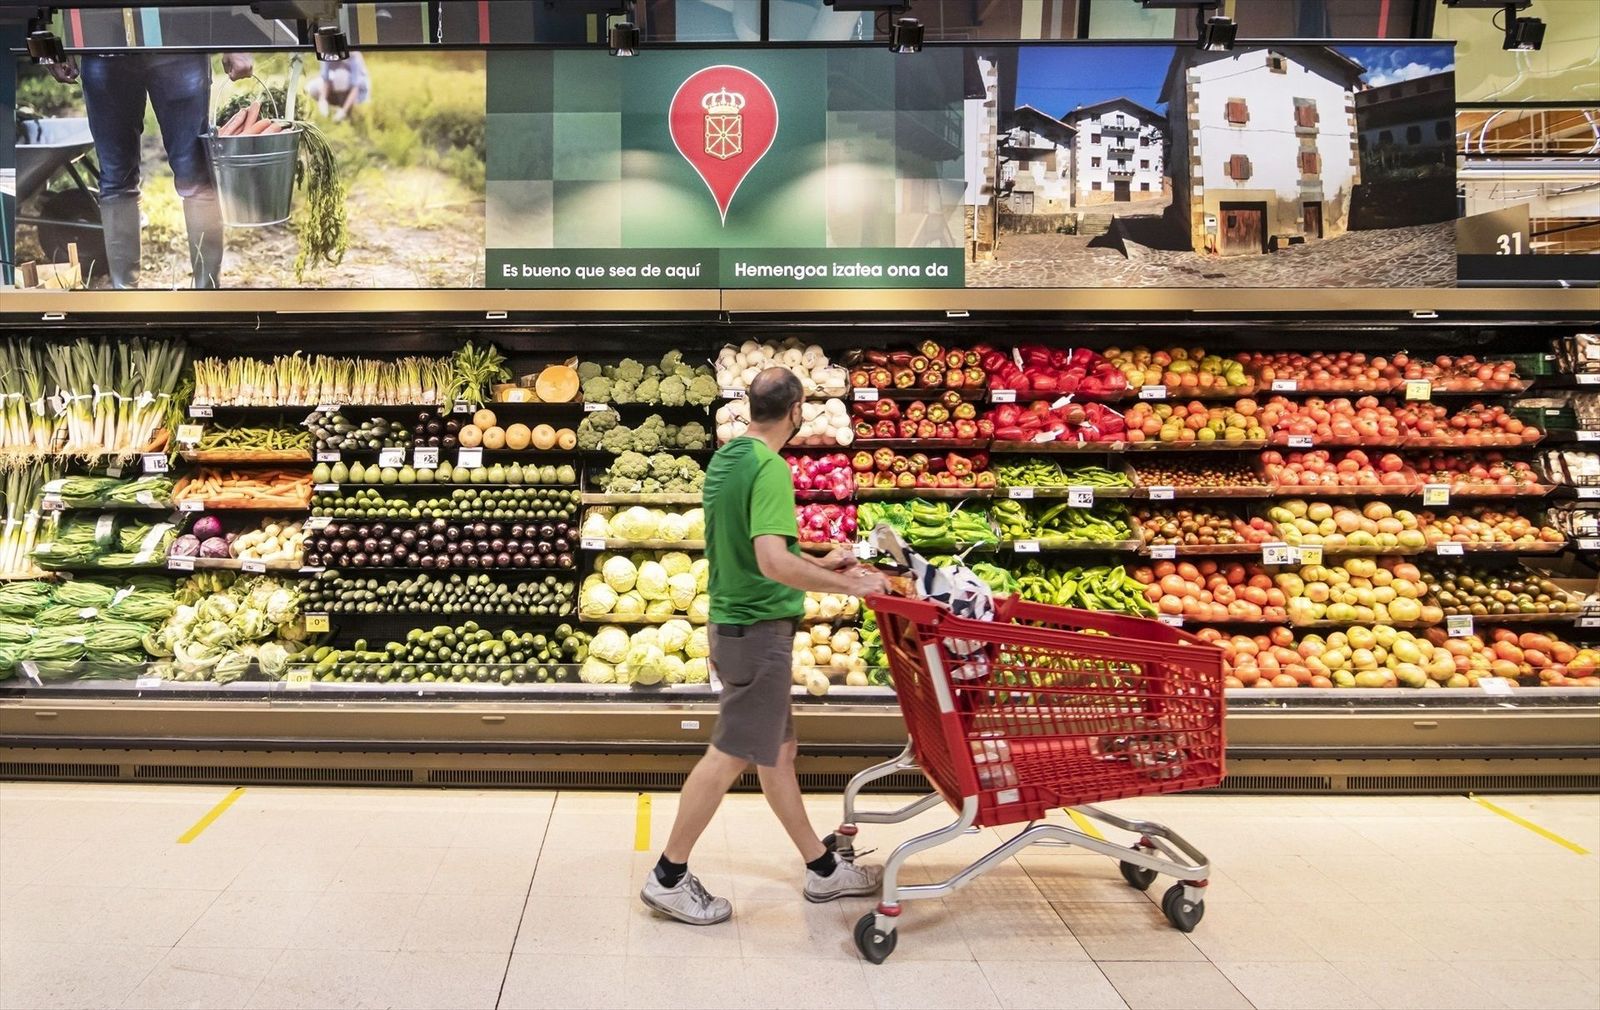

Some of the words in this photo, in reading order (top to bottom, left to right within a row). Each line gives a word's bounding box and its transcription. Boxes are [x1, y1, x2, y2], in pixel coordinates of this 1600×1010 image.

[1496, 231, 1522, 255] 31
[503, 264, 518, 278] Es
[523, 264, 571, 278] bueno
[576, 266, 605, 280] que
[609, 266, 636, 278] sea
[640, 264, 662, 278] de
[666, 262, 701, 280] aquí
[735, 263, 827, 281] Hemengoa
[833, 262, 882, 278] izatea
[887, 265, 920, 278] ona
[925, 263, 949, 278] da
